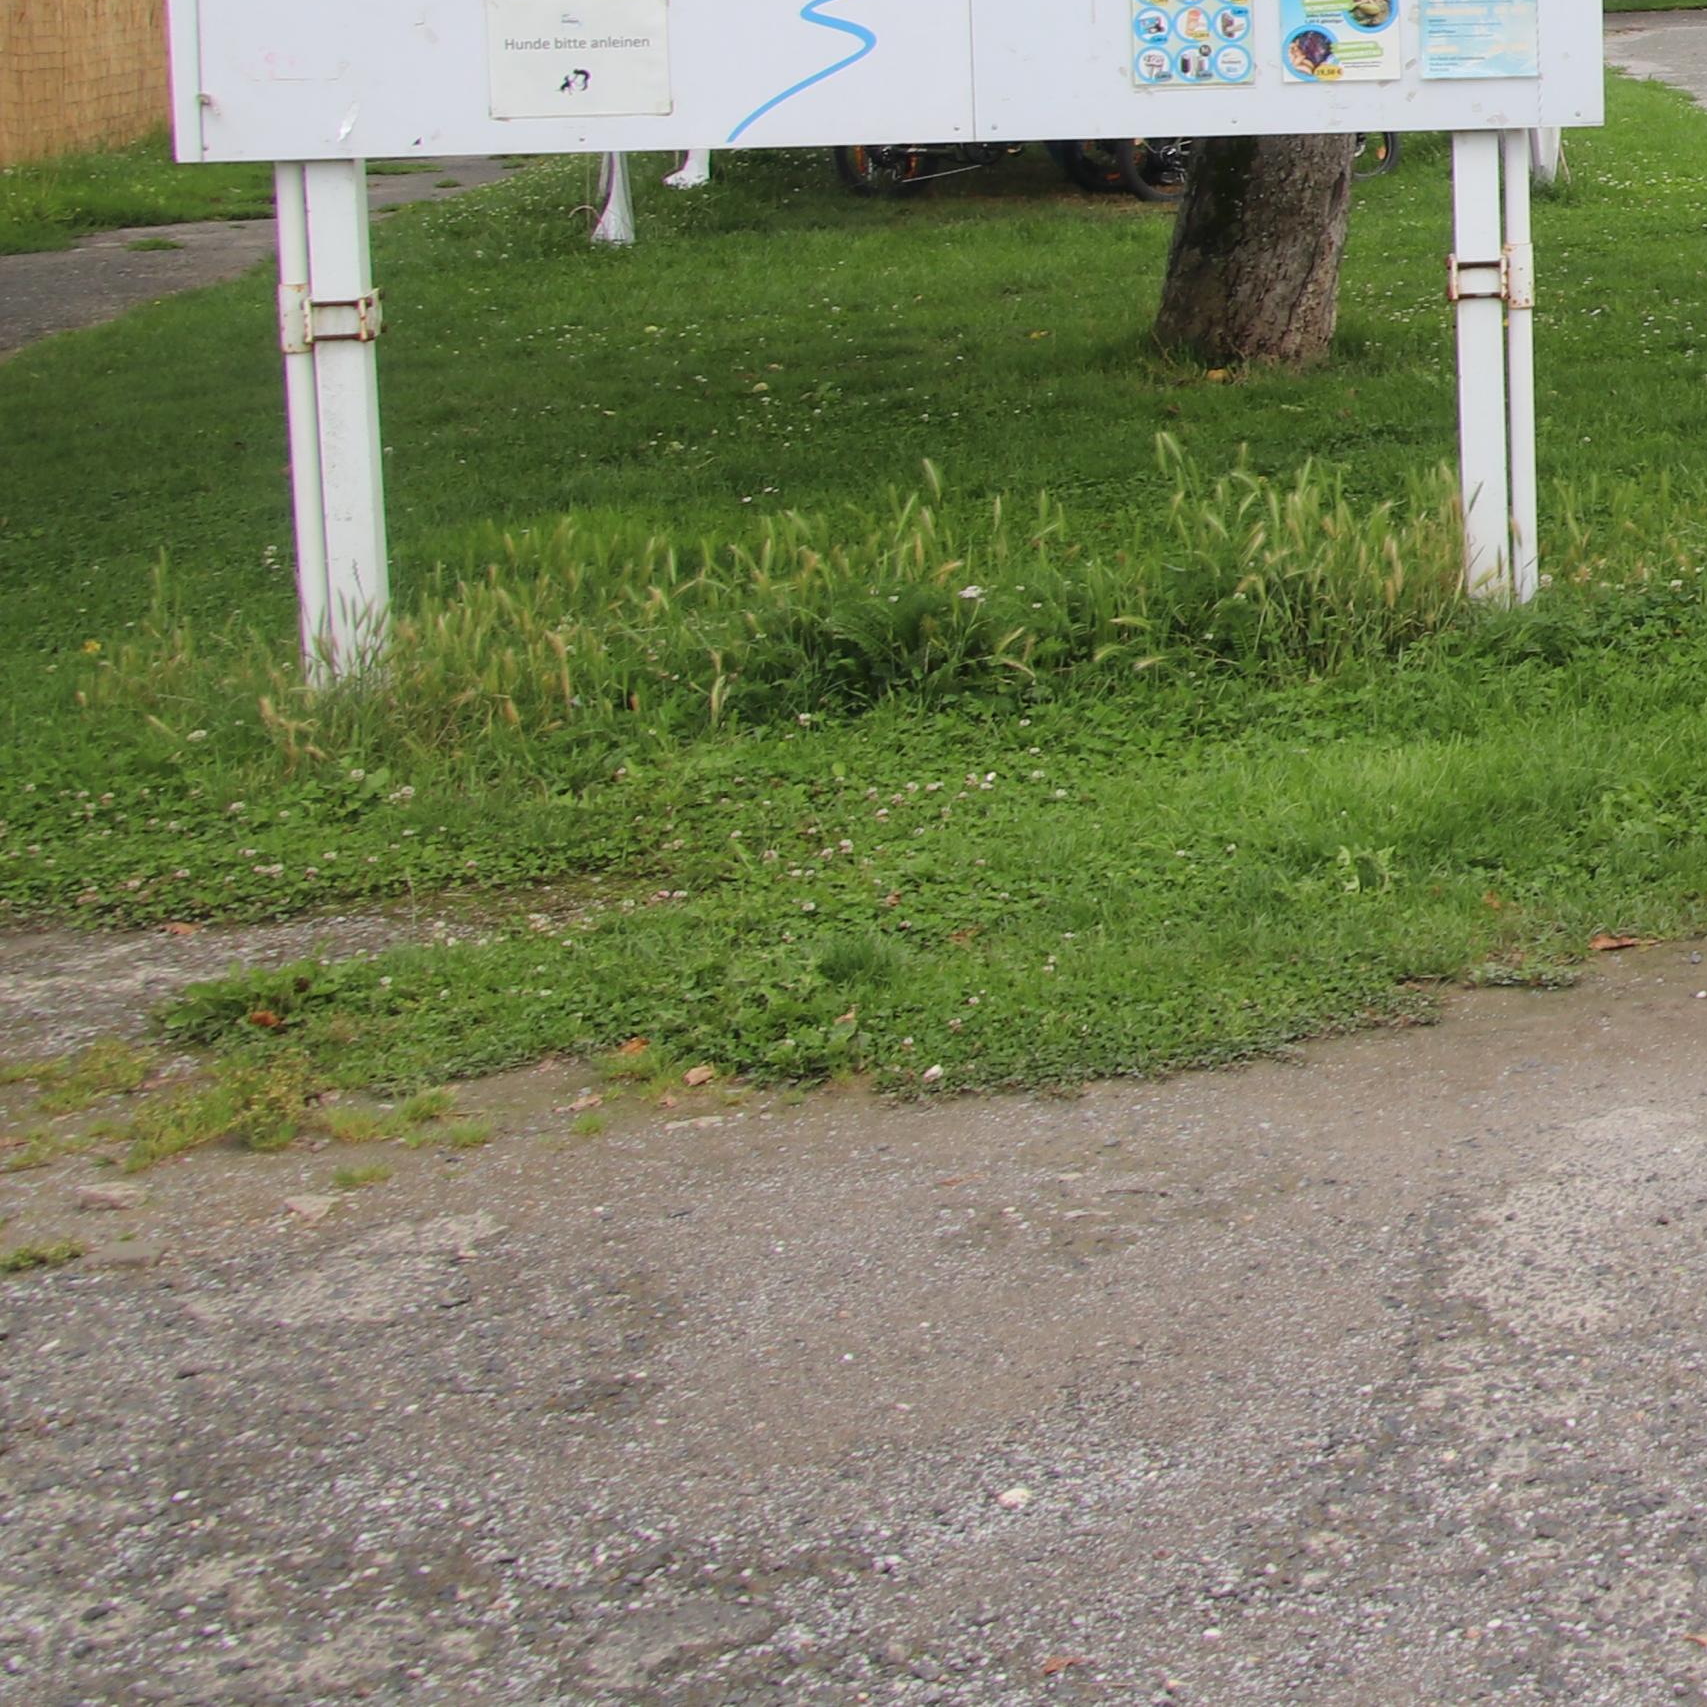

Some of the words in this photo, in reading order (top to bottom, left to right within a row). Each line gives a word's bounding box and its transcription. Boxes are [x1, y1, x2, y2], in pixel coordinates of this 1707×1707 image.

[504, 38, 551, 51] Hunde
[553, 37, 587, 50] bitte
[590, 35, 651, 49] anleinen
